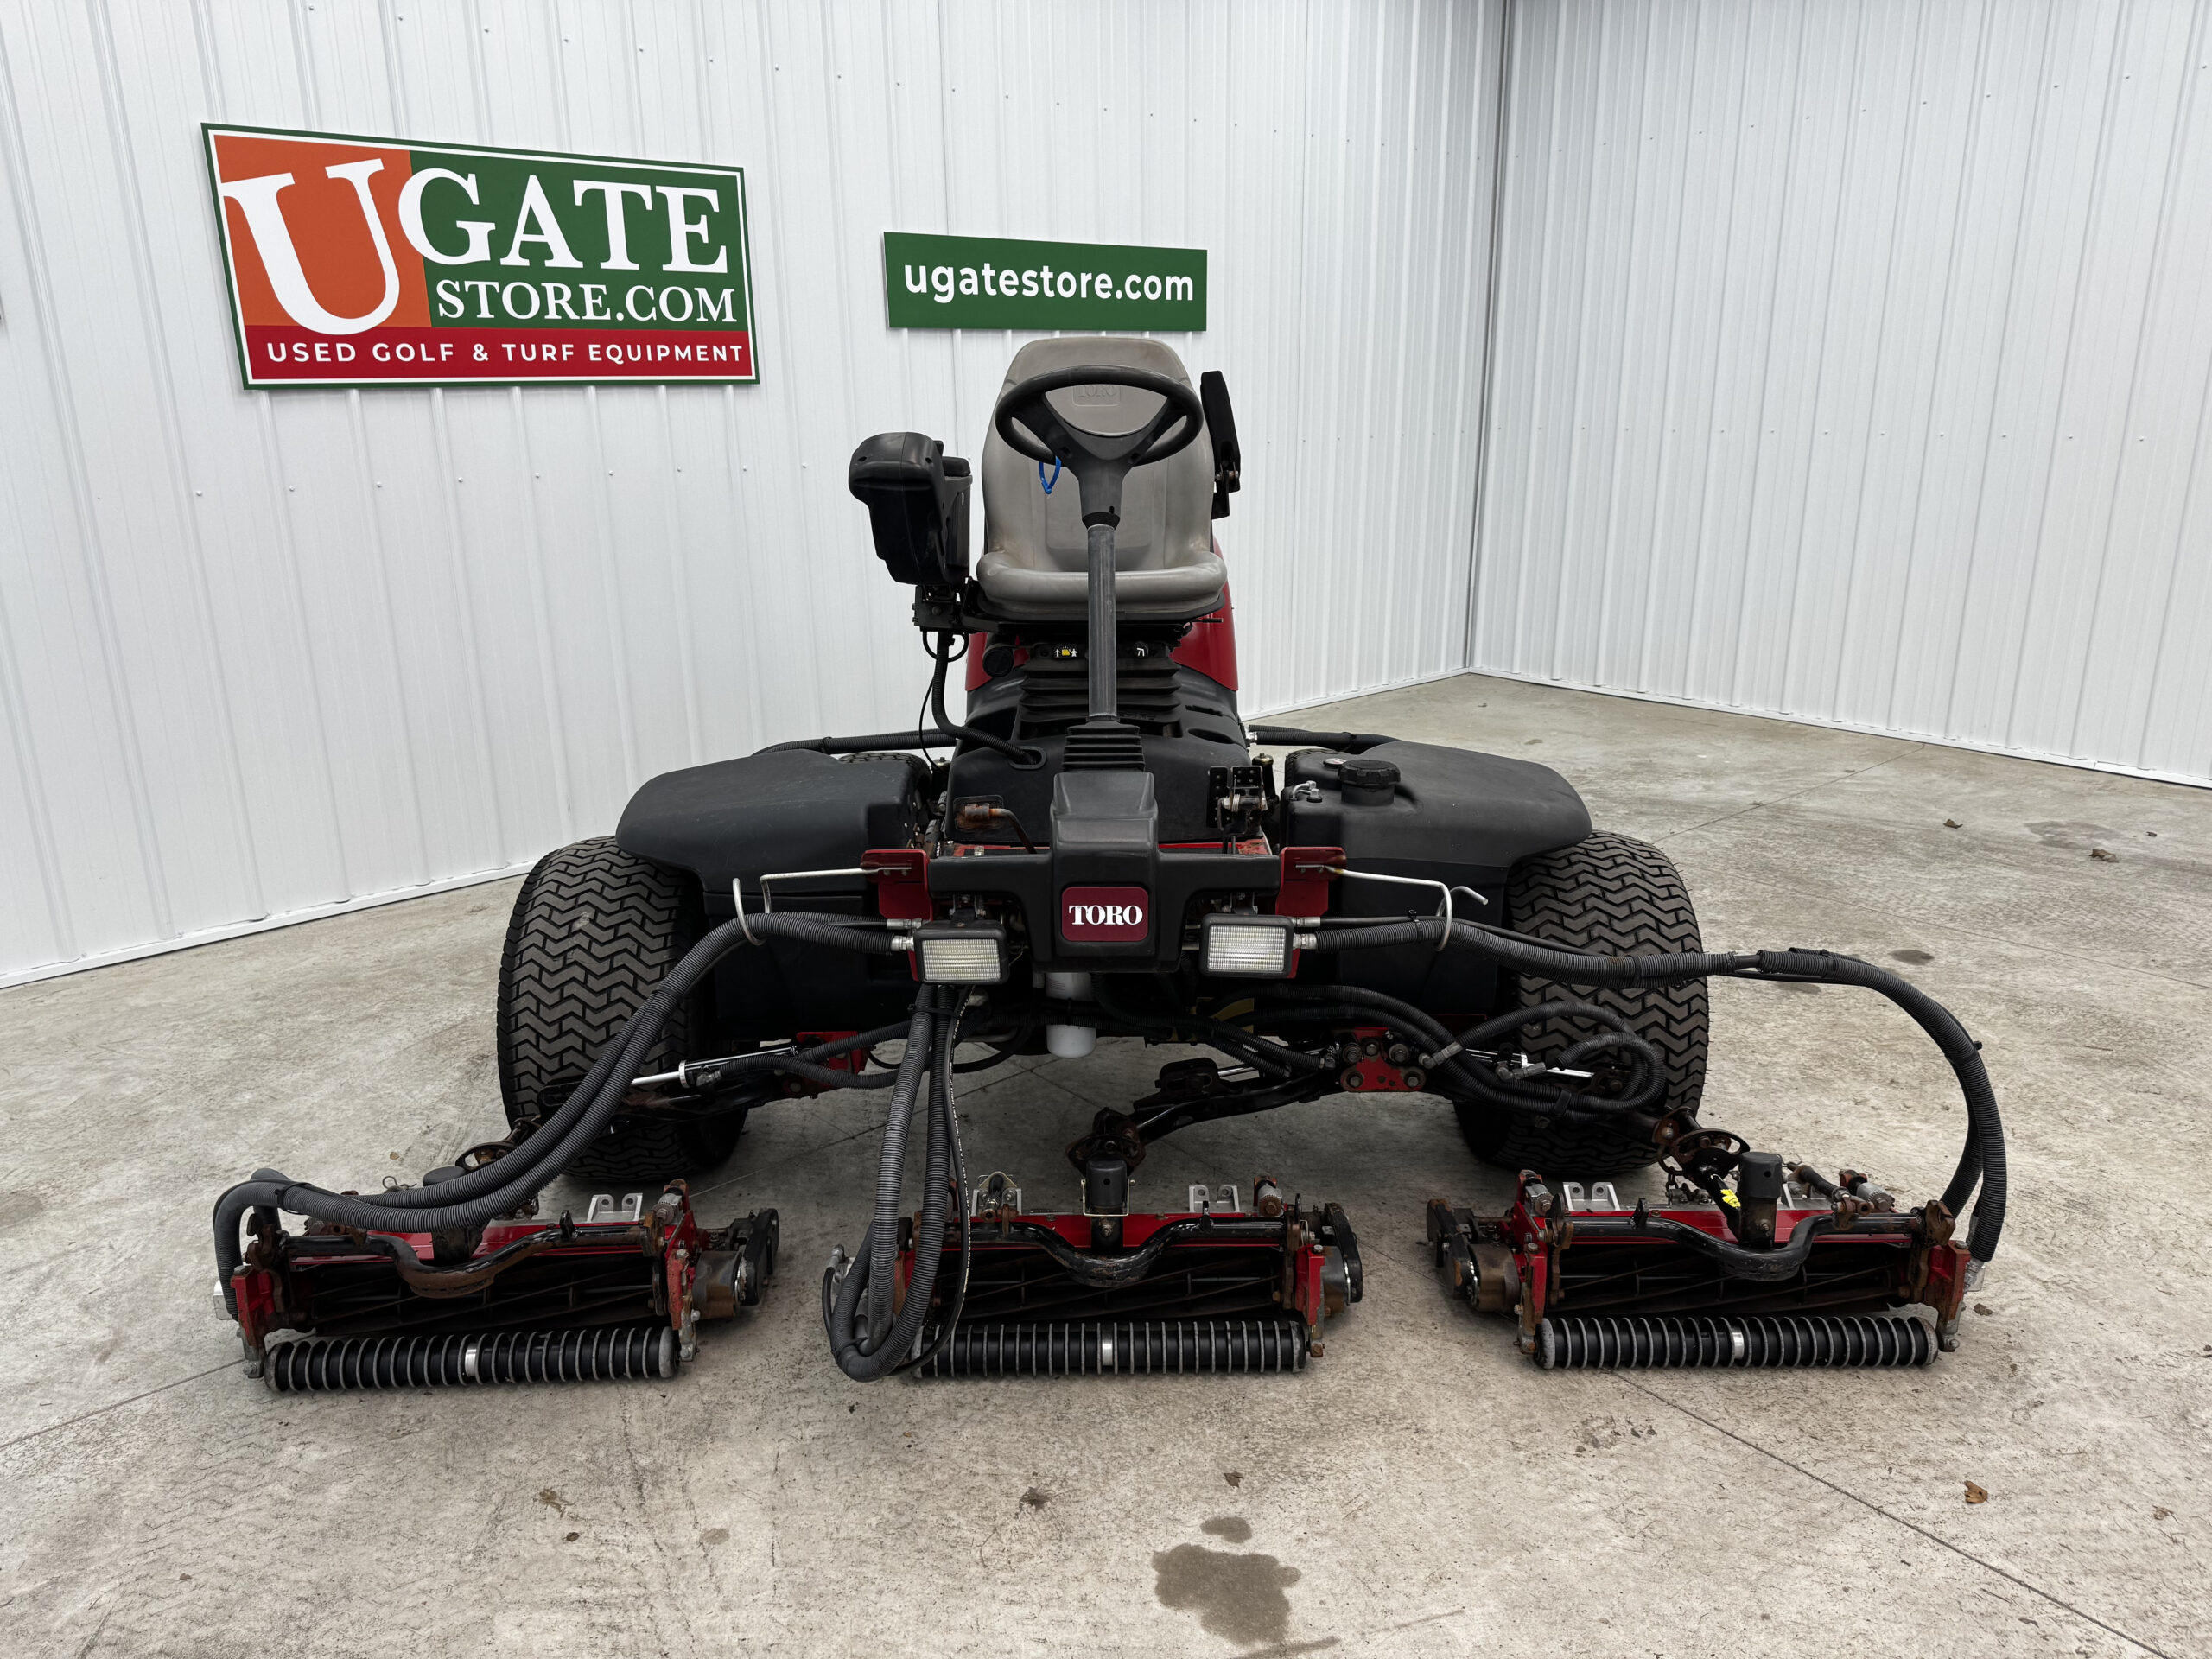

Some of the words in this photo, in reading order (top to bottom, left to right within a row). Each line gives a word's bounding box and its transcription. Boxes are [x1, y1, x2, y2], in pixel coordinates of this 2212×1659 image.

[904, 263, 1193, 304] ugatestore.com
[436, 279, 738, 322] STORE.COM
[267, 342, 356, 362] USED
[372, 342, 454, 362] GOLF
[473, 343, 489, 362] &
[501, 343, 574, 362] TURF
[588, 344, 742, 365] EQUIPMENT
[1068, 904, 1143, 925] TORO
